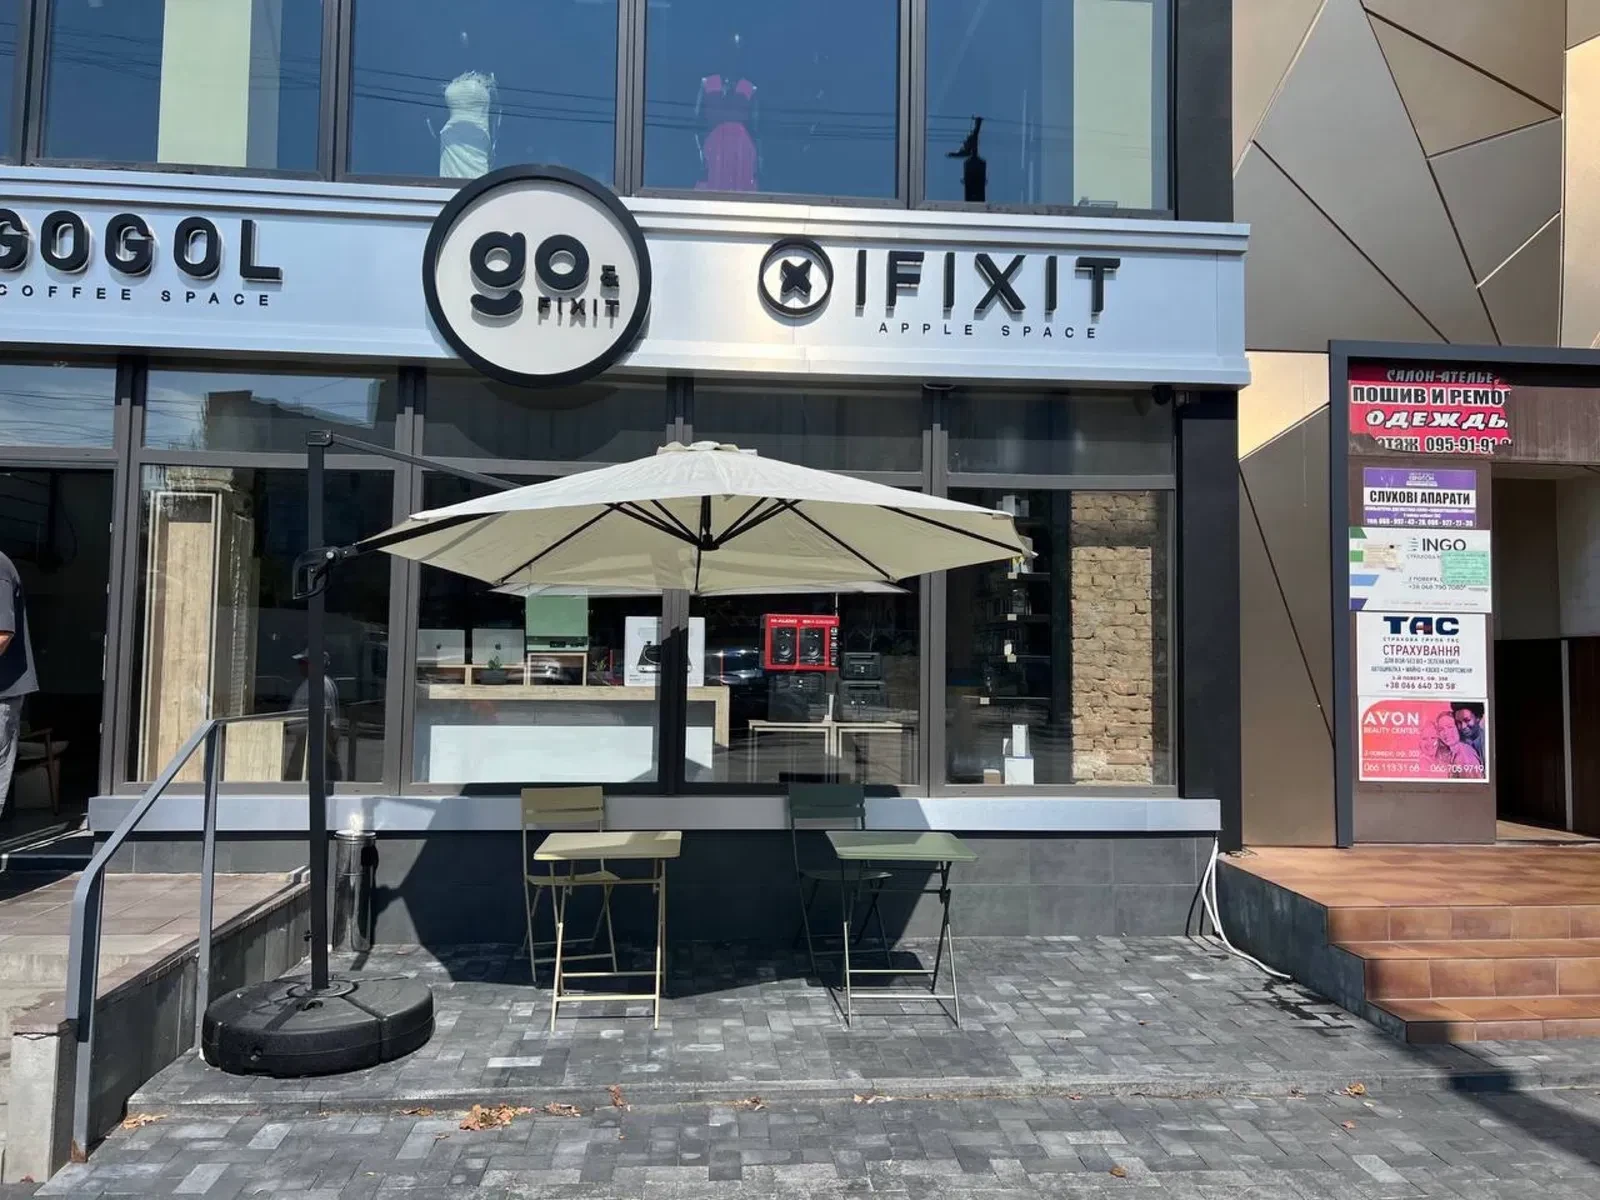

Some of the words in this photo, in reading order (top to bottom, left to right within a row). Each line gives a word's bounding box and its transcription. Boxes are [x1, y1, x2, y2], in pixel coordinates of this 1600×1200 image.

[0, 208, 282, 282] GOGOL
[470, 231, 590, 316] go
[856, 249, 1121, 313] IFIXIT
[161, 290, 268, 306] SPACE
[538, 296, 620, 317] FIXIT
[879, 323, 973, 336] APPLE
[1001, 325, 1095, 339] SPACE
[1353, 386, 1426, 404] ПОШИВ
[1431, 388, 1442, 404] И
[1369, 490, 1418, 504] СЛУХОВІ
[1420, 491, 1470, 505] АПАРАТИ
[1422, 538, 1467, 552] INGO
[1383, 644, 1460, 657] СТРАХУВАННЯ
[1364, 712, 1419, 725] AVON
